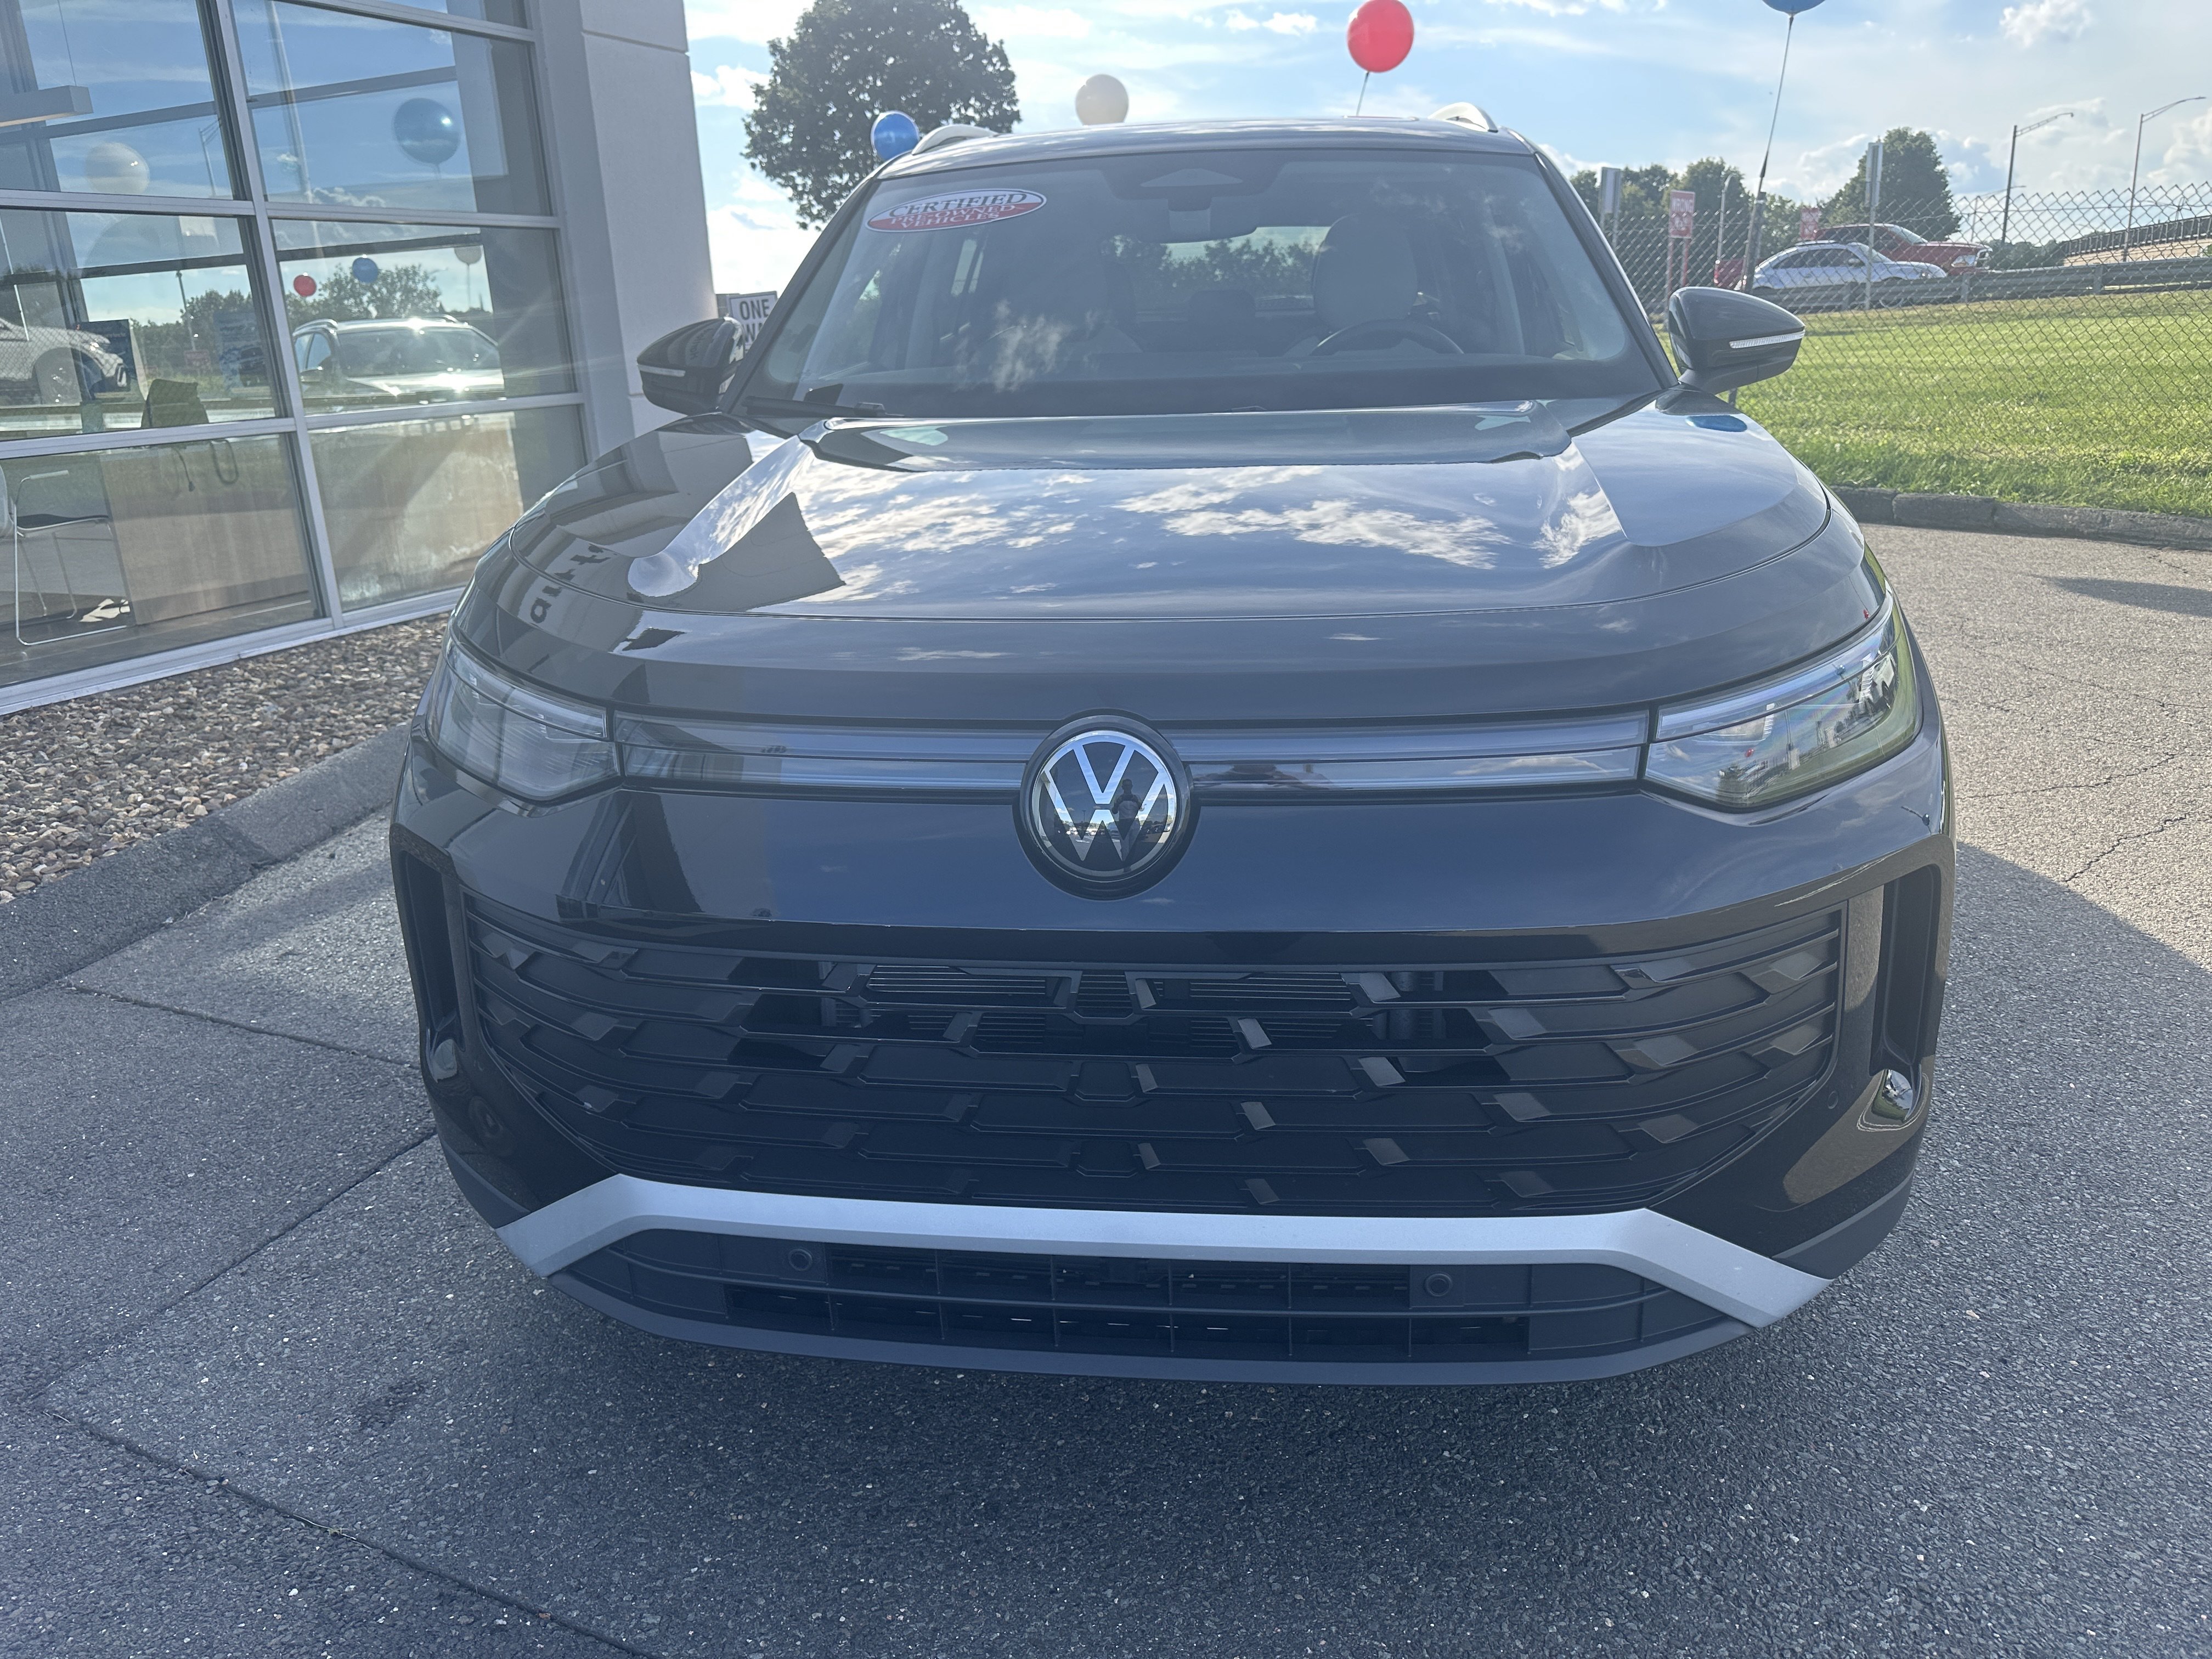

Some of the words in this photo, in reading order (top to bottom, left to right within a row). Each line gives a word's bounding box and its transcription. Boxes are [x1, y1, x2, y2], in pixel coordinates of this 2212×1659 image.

[889, 193, 1028, 217] CERTIFIED
[891, 205, 1015, 224] PRE-OWNED
[901, 212, 999, 228] VEHICLES
[740, 299, 769, 320] ONE
